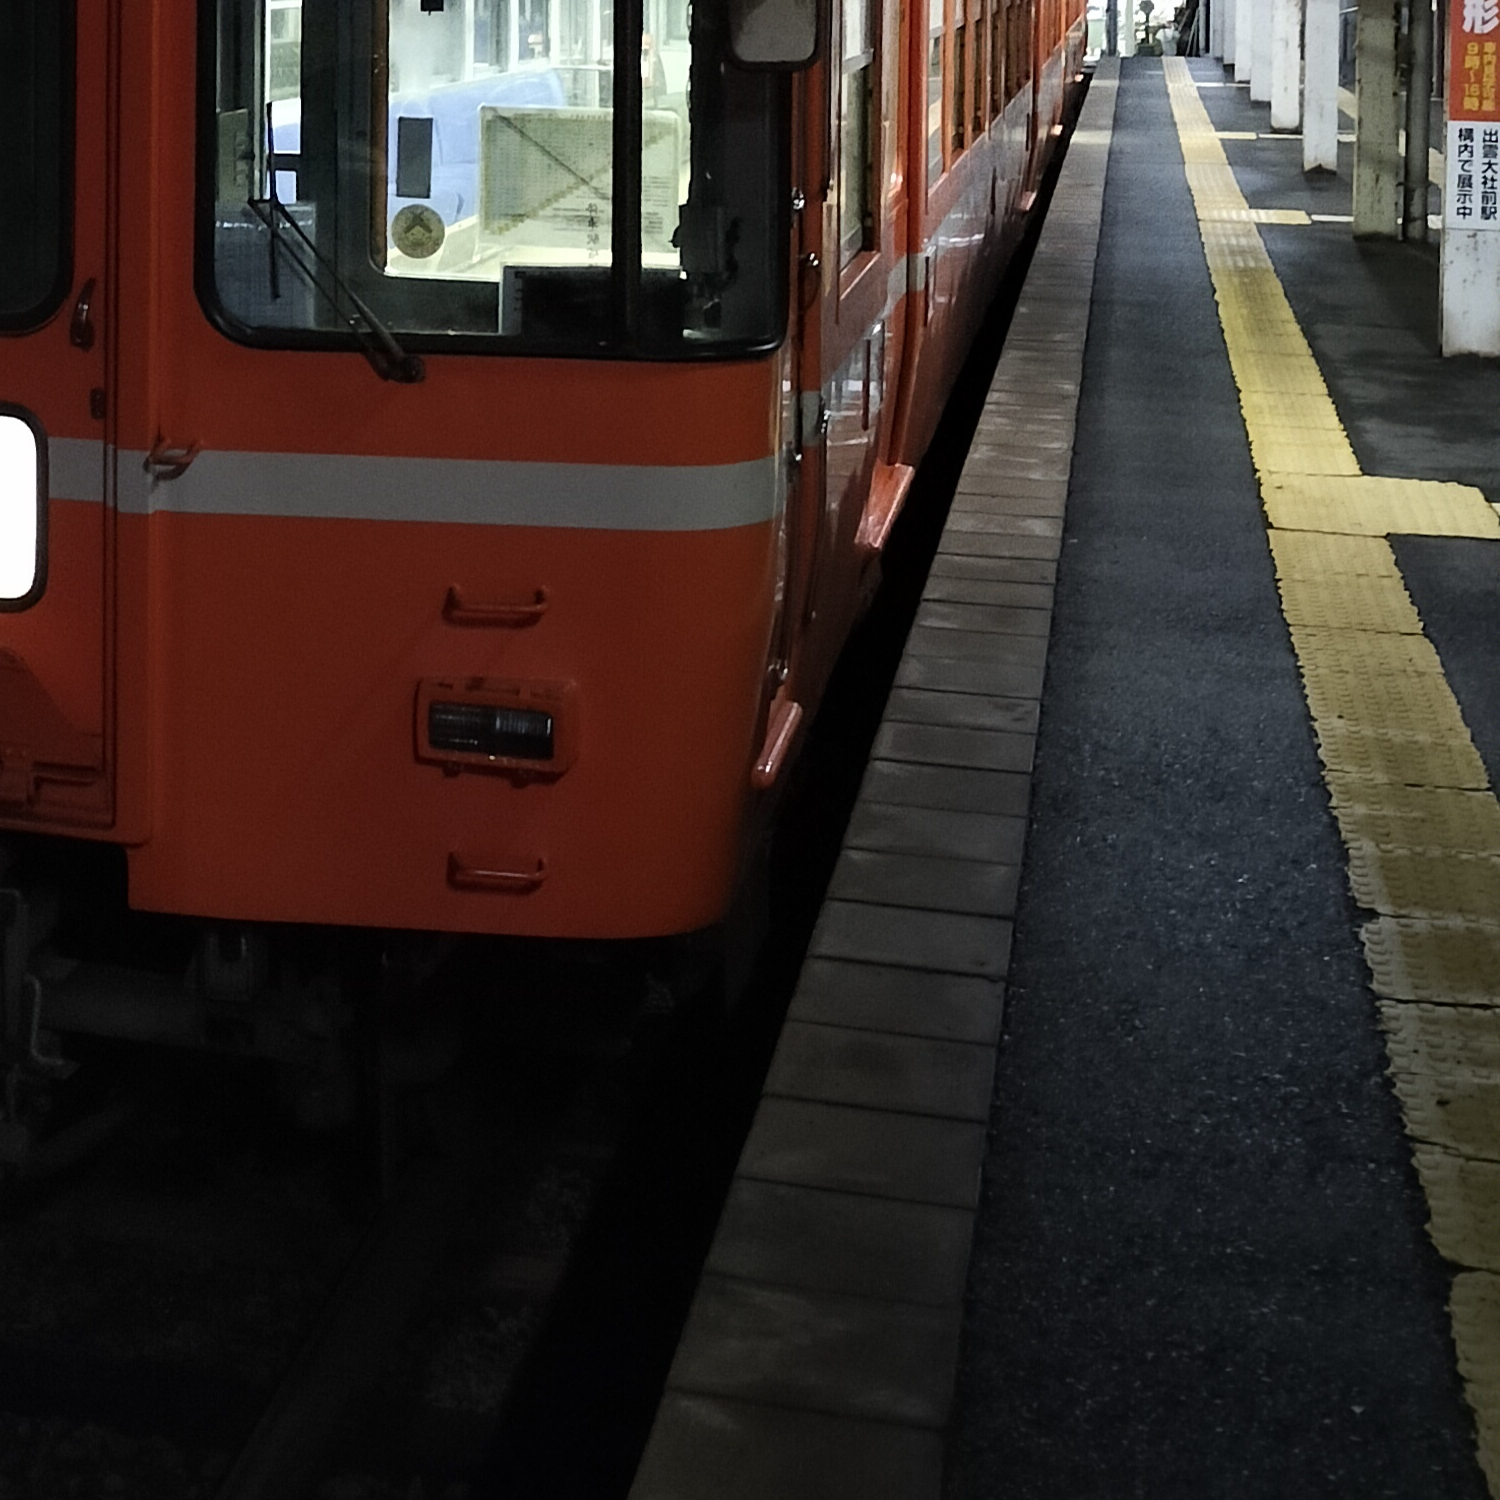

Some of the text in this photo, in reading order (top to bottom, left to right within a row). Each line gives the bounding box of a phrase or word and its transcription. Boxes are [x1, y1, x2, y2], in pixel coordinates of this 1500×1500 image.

[1457, 127, 1474, 220] 構内で展示中
[1481, 128, 1498, 220] 出雲大社前駅
